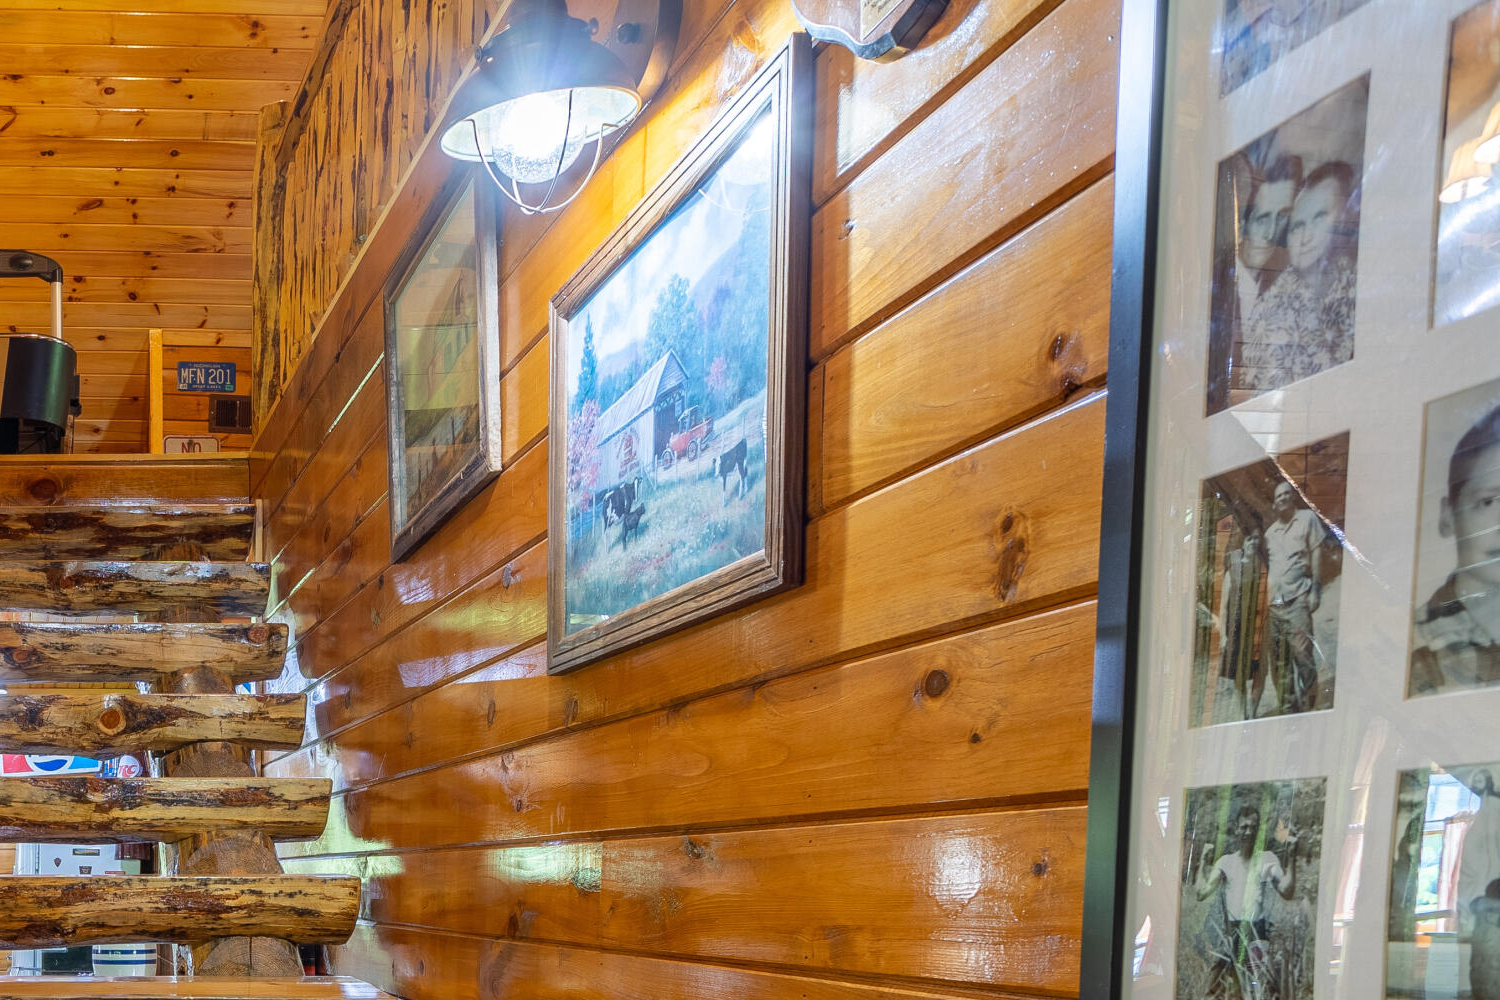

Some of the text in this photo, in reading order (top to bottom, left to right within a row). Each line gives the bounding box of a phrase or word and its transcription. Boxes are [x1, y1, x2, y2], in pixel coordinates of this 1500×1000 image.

[180, 368, 231, 385] MFN 201
[181, 441, 202, 453] NO
[118, 764, 136, 777] RC
